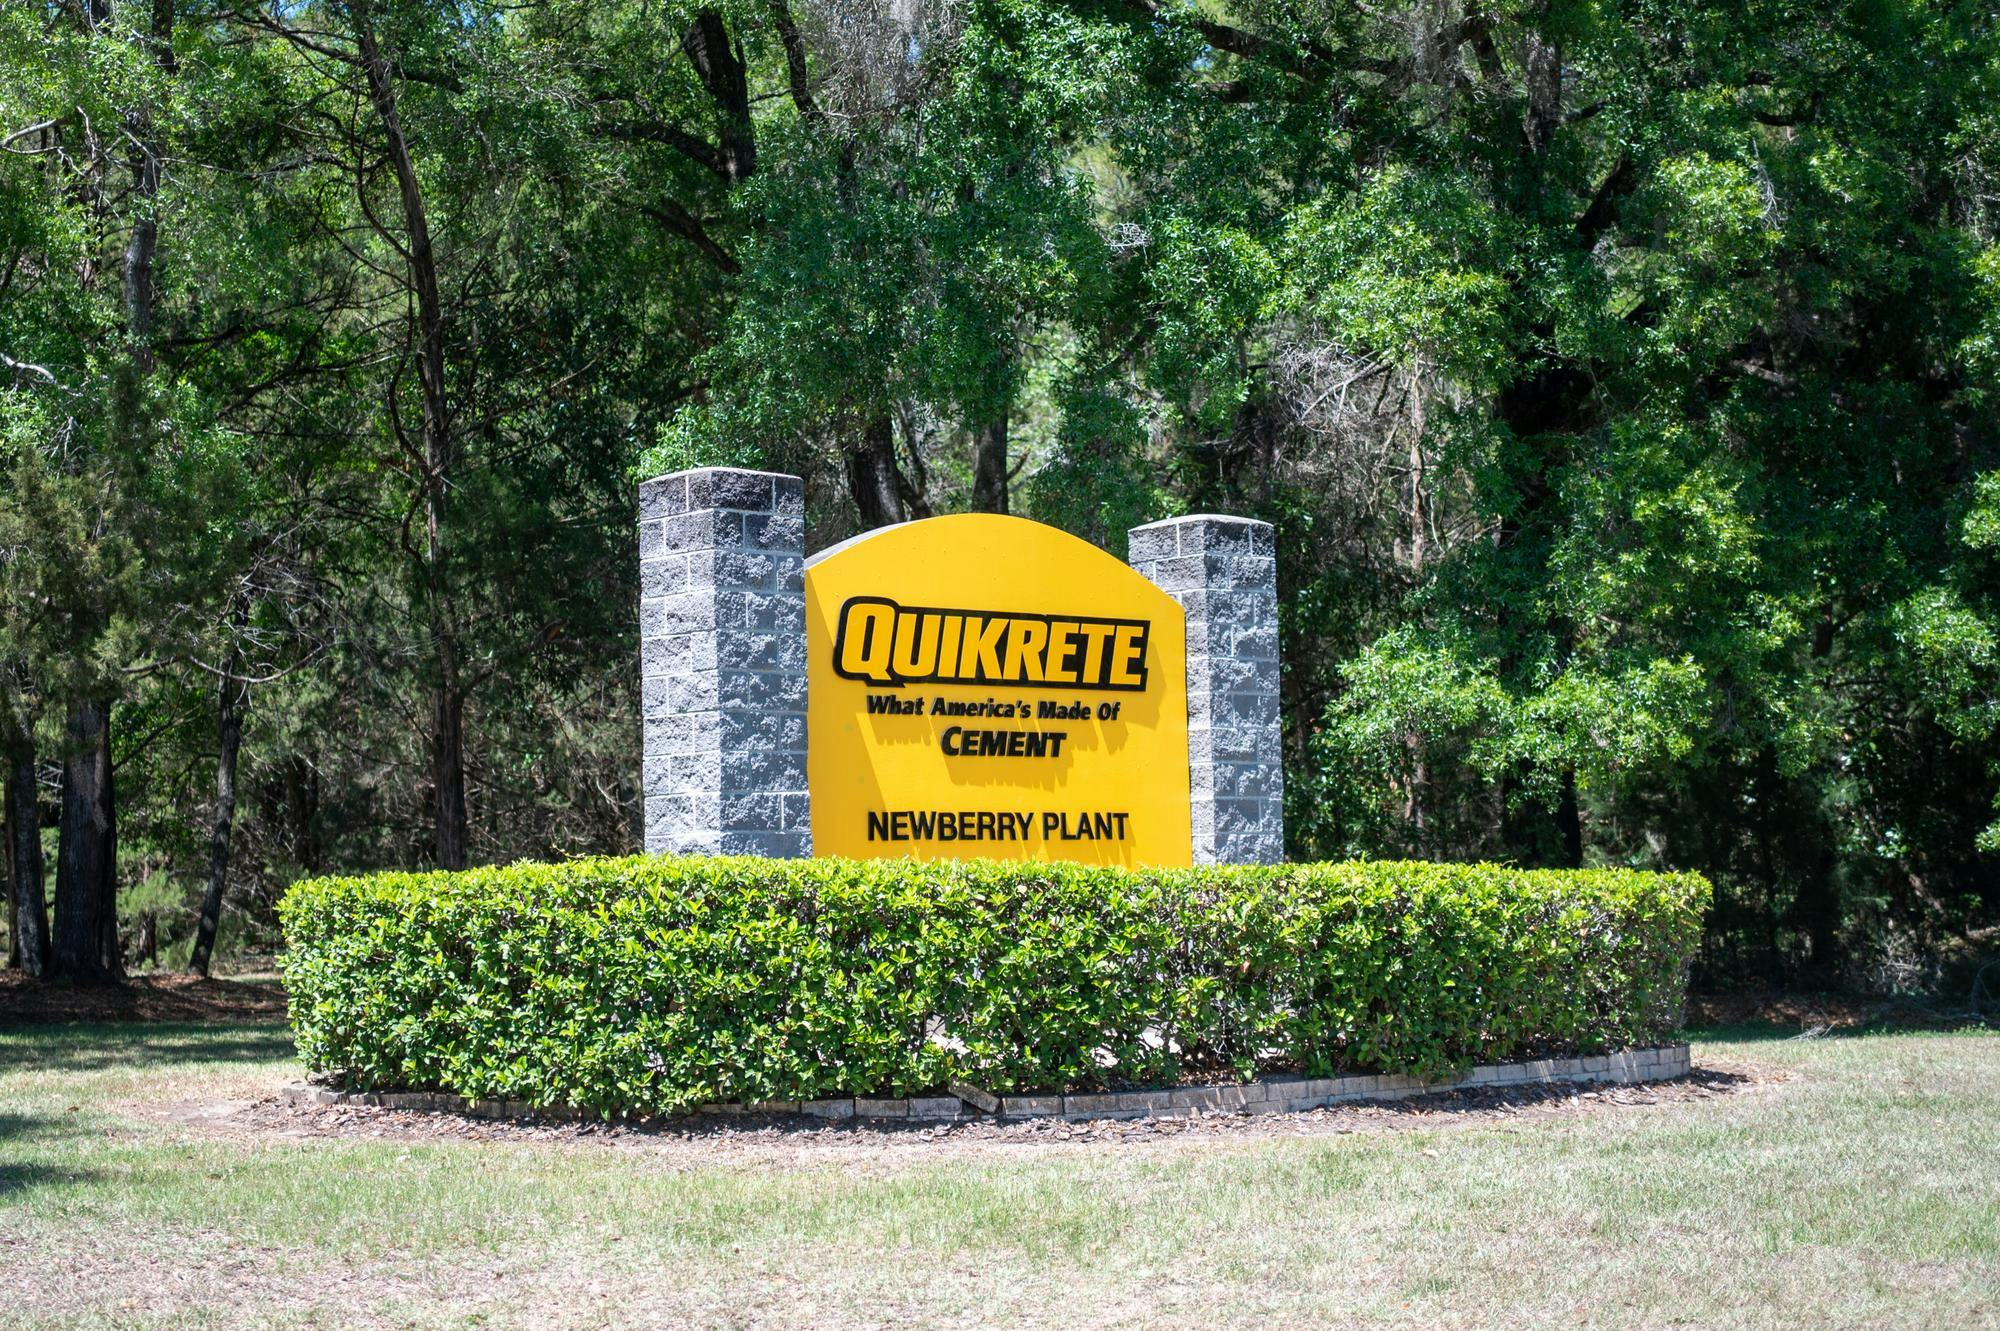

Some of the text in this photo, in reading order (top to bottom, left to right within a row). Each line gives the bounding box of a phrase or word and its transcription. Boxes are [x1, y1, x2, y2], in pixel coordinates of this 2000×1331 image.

[839, 601, 1147, 687] QUIKRETE
[866, 695, 1121, 721] What America's Made Of
[941, 726, 1067, 758] CEMENT
[867, 811, 1129, 841] NEWBERRY PLANT
